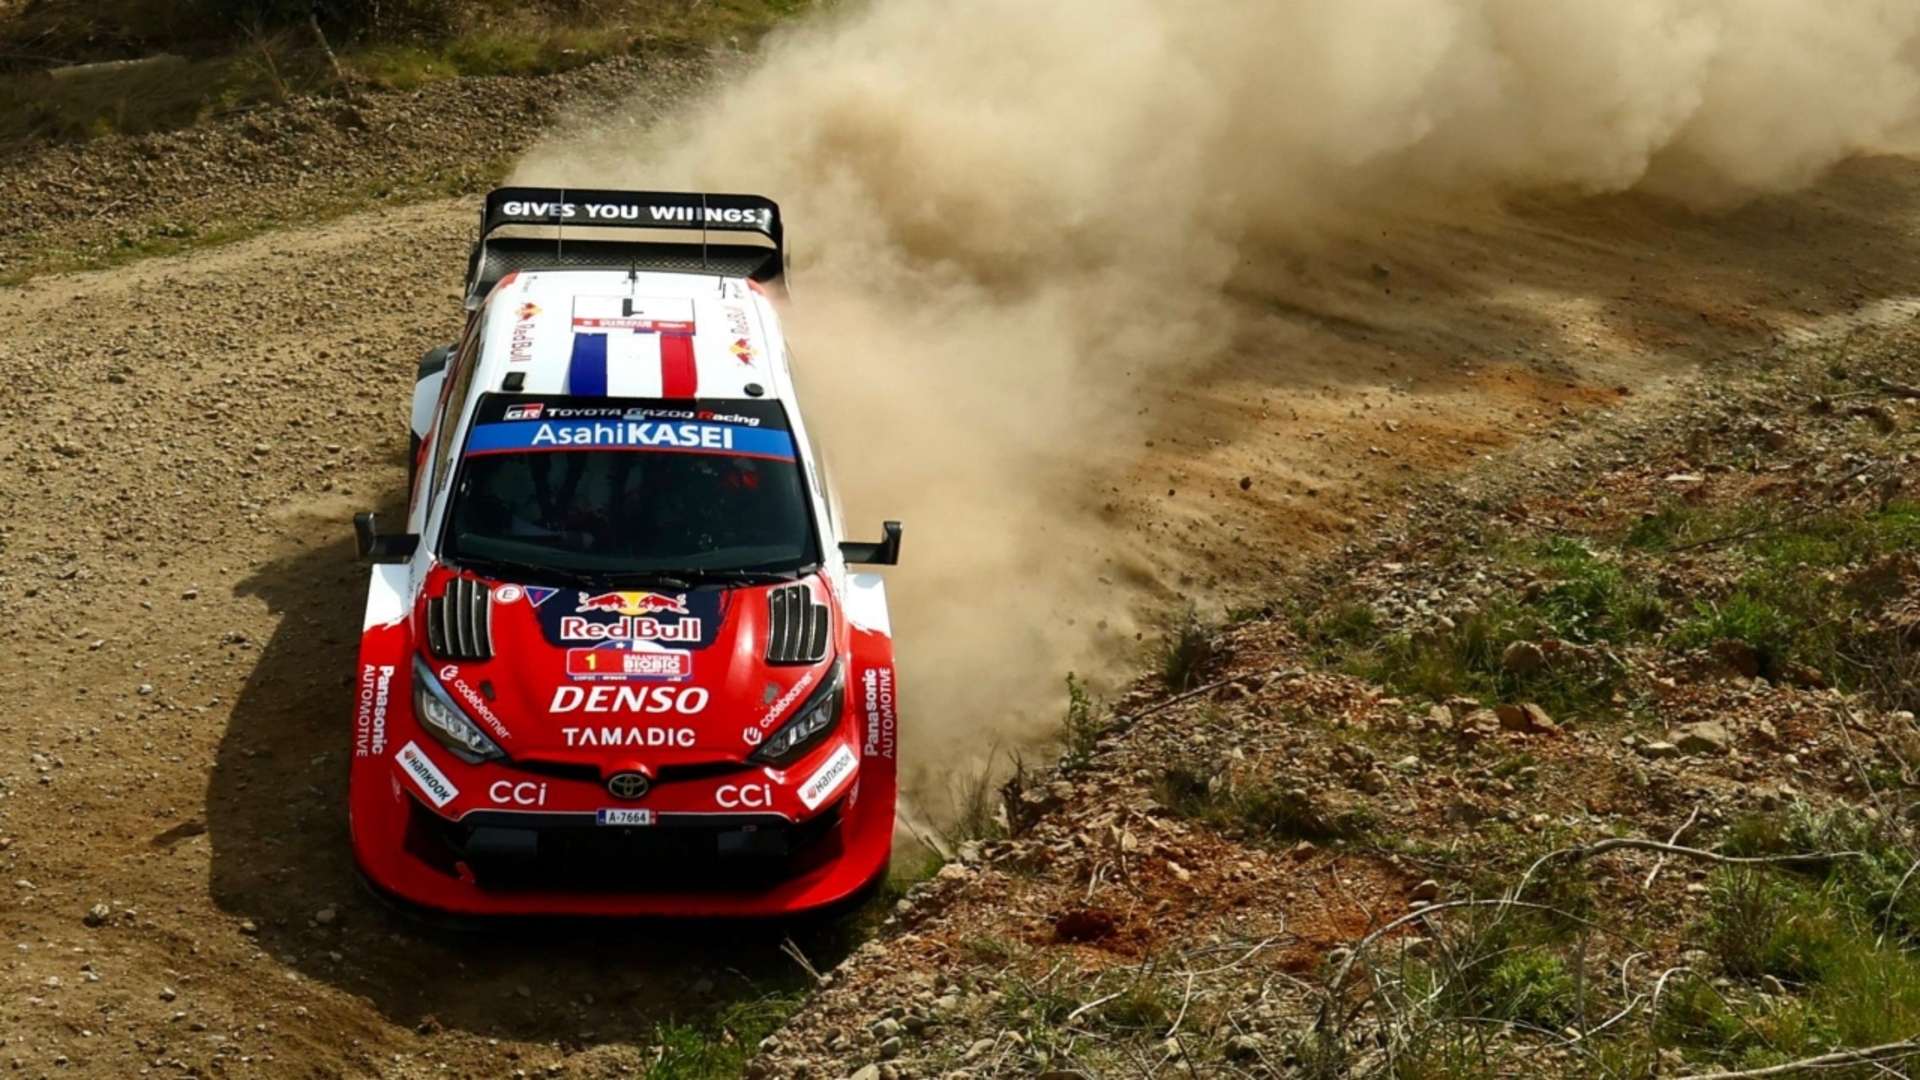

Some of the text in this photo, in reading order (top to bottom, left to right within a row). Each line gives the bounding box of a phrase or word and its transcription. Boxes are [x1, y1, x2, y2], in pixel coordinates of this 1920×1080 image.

[503, 201, 576, 217] GIVES
[585, 203, 638, 219] YOU
[504, 408, 541, 420] GR
[546, 408, 621, 417] TOYOTA
[698, 411, 760, 426] Racing
[502, 589, 516, 600] E
[561, 616, 701, 642] Red Bull
[585, 654, 597, 670] 1
[623, 659, 680, 670] BIOBIO
[356, 664, 375, 757] AUTOMOTIVE
[372, 665, 395, 755] Panasonic
[454, 679, 510, 739] codebeamer
[549, 686, 709, 714] DENSO
[760, 671, 814, 728] codebeamer
[862, 669, 878, 757] Panasonic
[879, 668, 894, 759] AUTOMOTIVE
[562, 727, 696, 747] TAMADIC
[608, 811, 646, 823] A-7664
